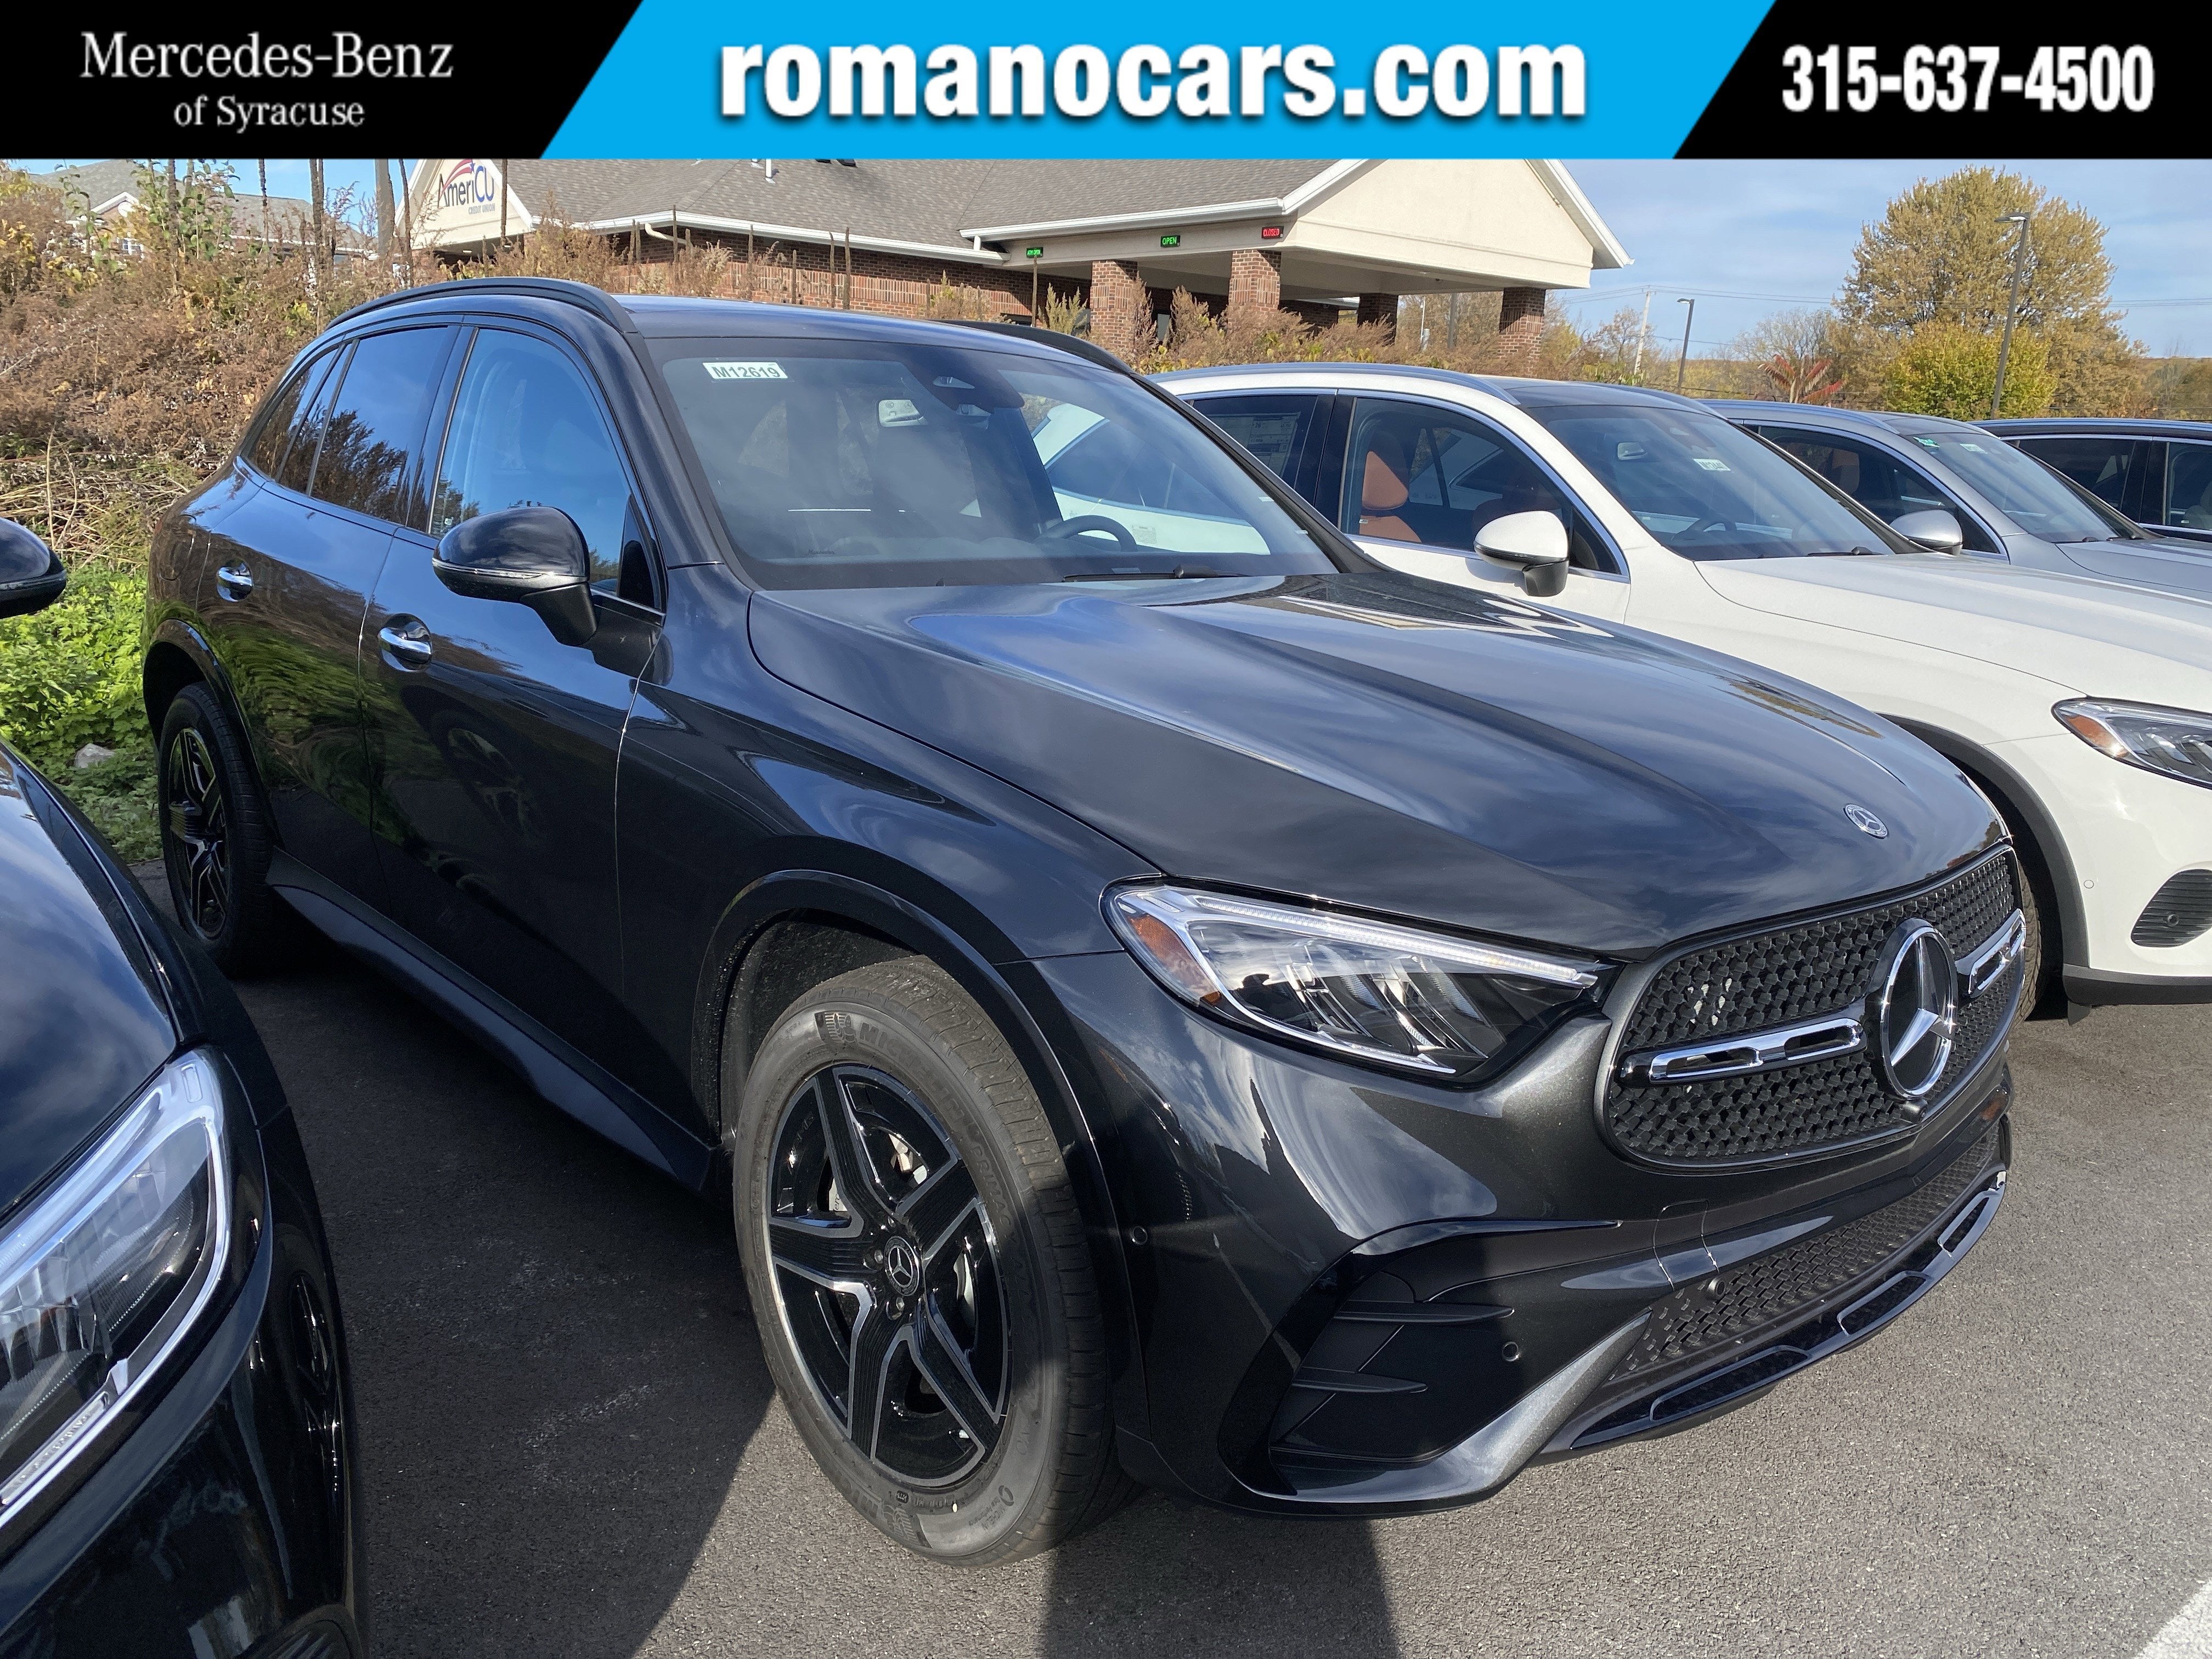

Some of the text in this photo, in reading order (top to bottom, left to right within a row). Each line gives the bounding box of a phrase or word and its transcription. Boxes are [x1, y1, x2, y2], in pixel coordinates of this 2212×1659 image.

[438, 165, 494, 208] AmeriCU
[468, 203, 495, 215] CREDIT UNION
[1162, 236, 1177, 245] OPEN
[711, 366, 780, 378] M12619
[859, 1022, 966, 1125] MICHELIN
[981, 1503, 1006, 1532] MICHELIN
